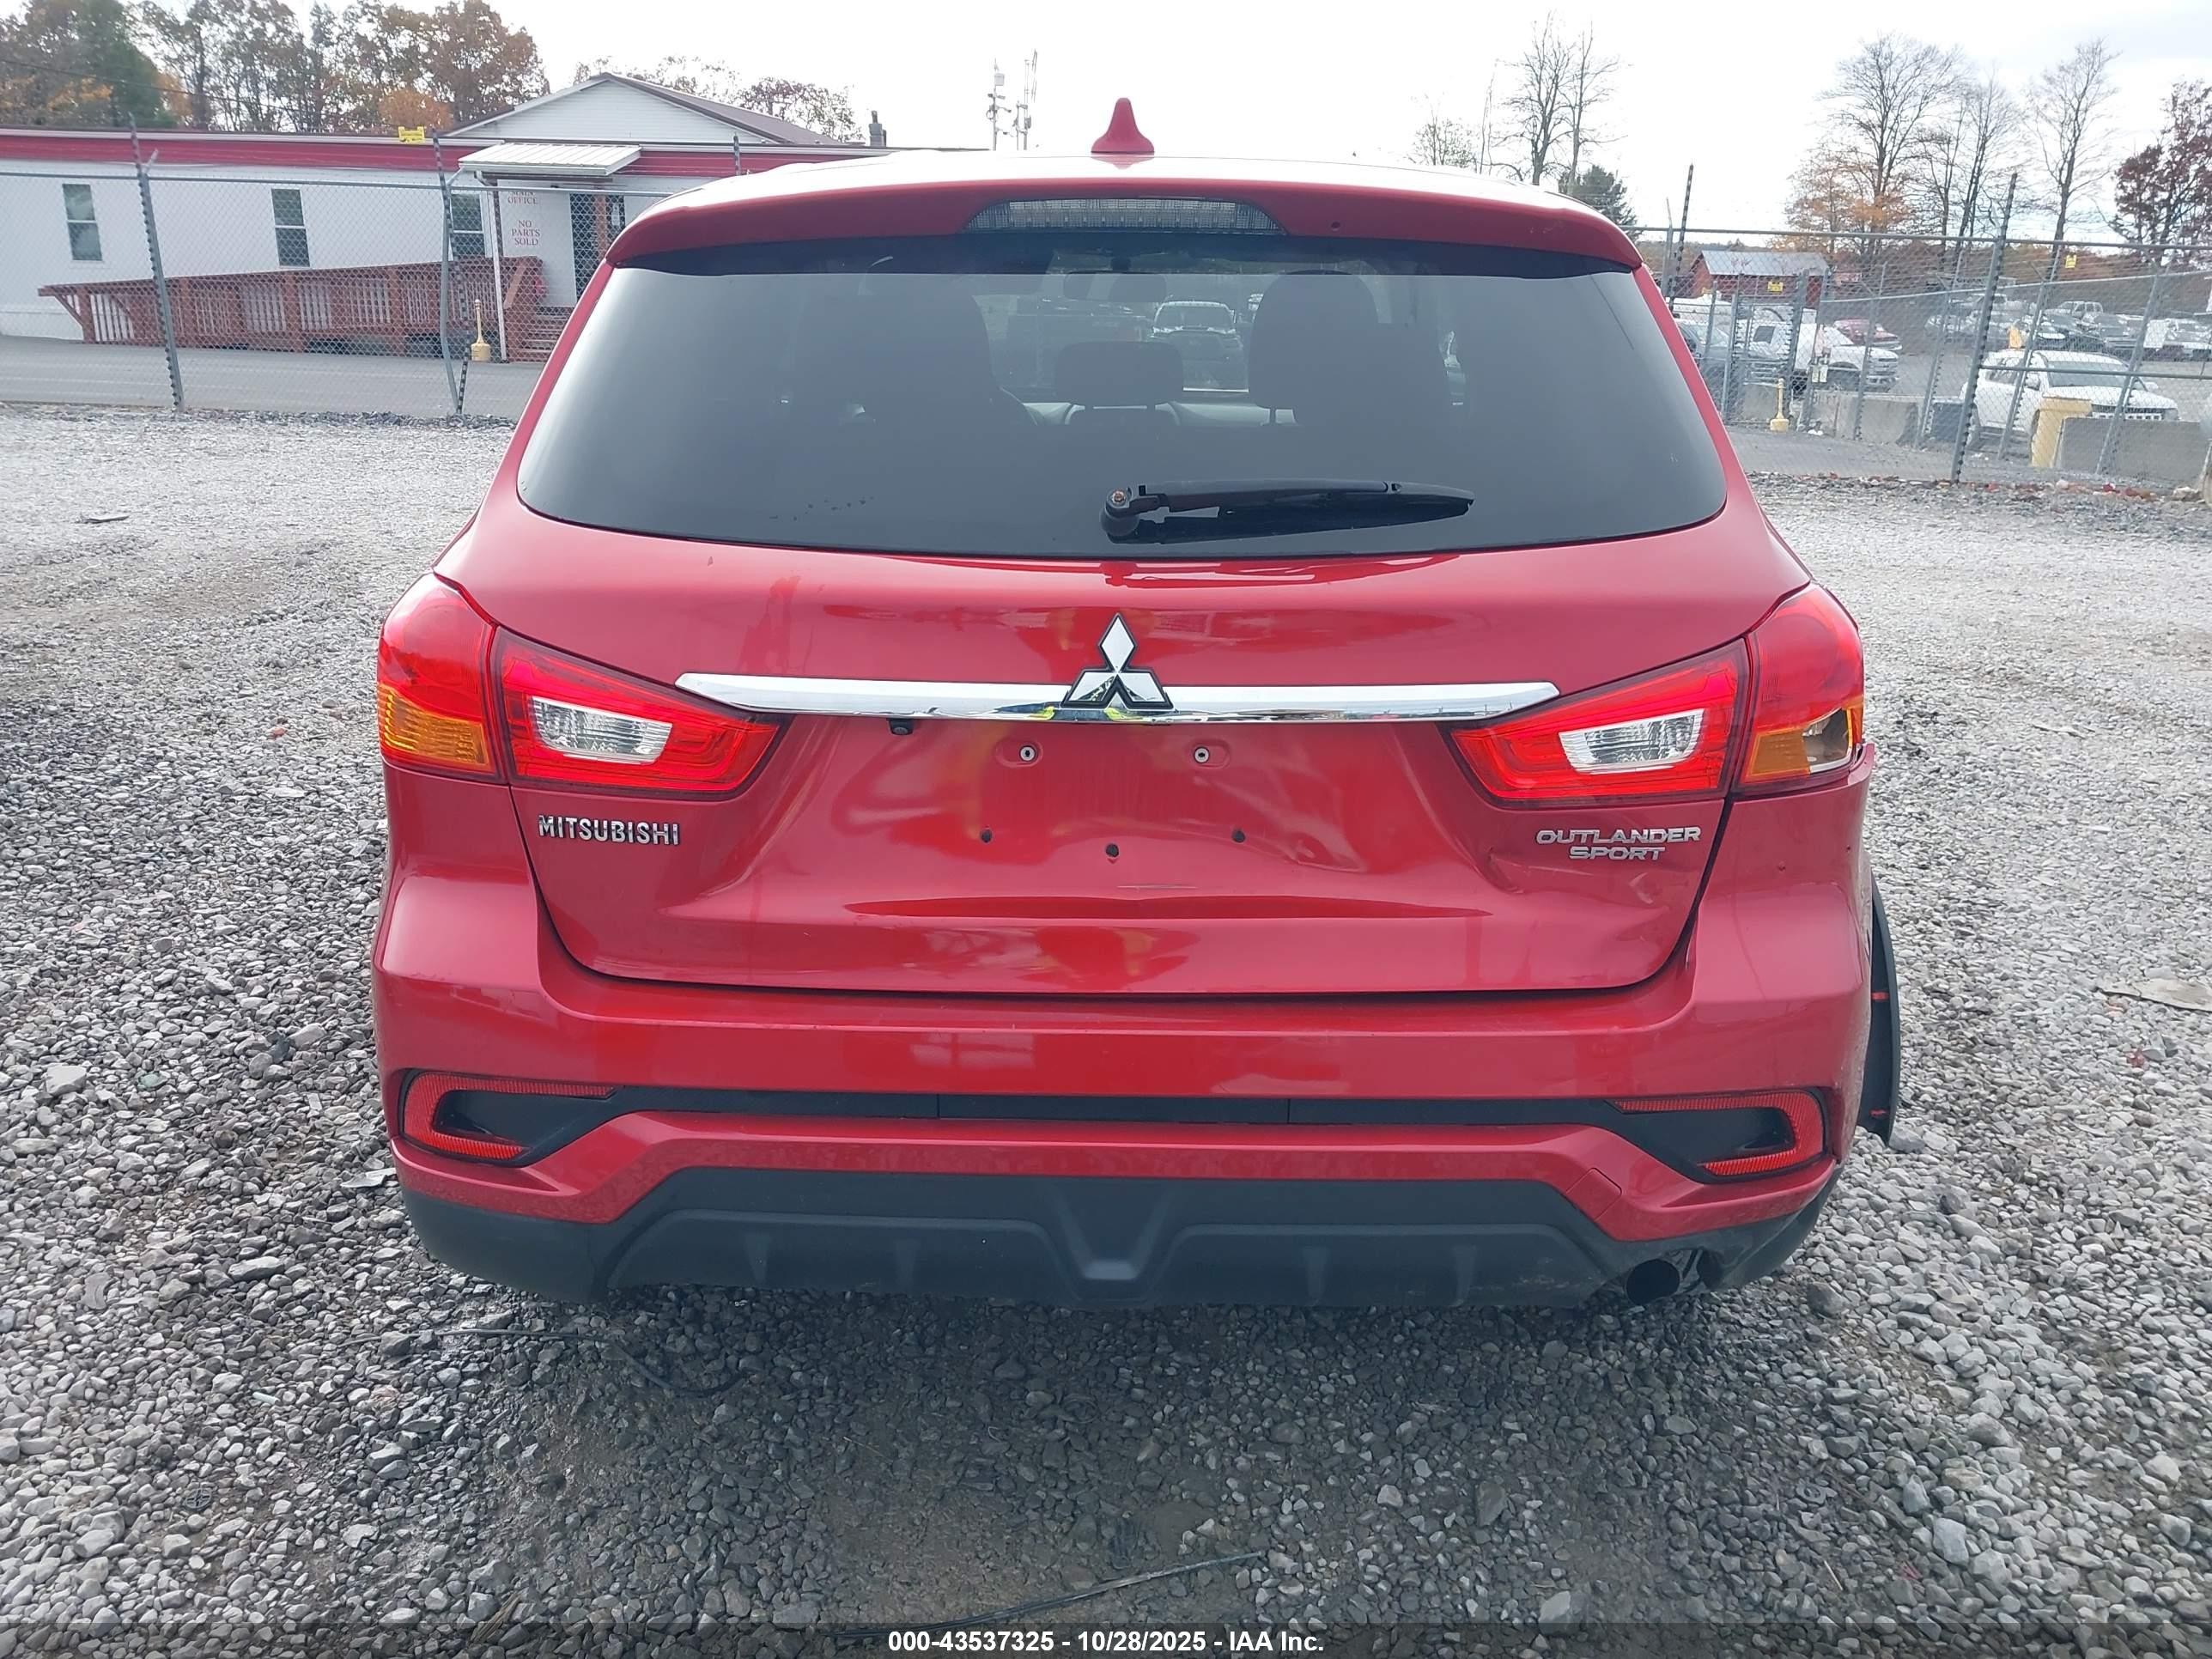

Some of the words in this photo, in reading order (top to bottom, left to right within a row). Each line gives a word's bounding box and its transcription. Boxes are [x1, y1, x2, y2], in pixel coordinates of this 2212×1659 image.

[507, 196, 538, 204] OFFICE
[511, 228, 540, 237] PARTS
[538, 815, 679, 845] MITSUBISHI
[1536, 826, 1701, 844] OUTLANDER
[1570, 846, 1665, 860] SPORT
